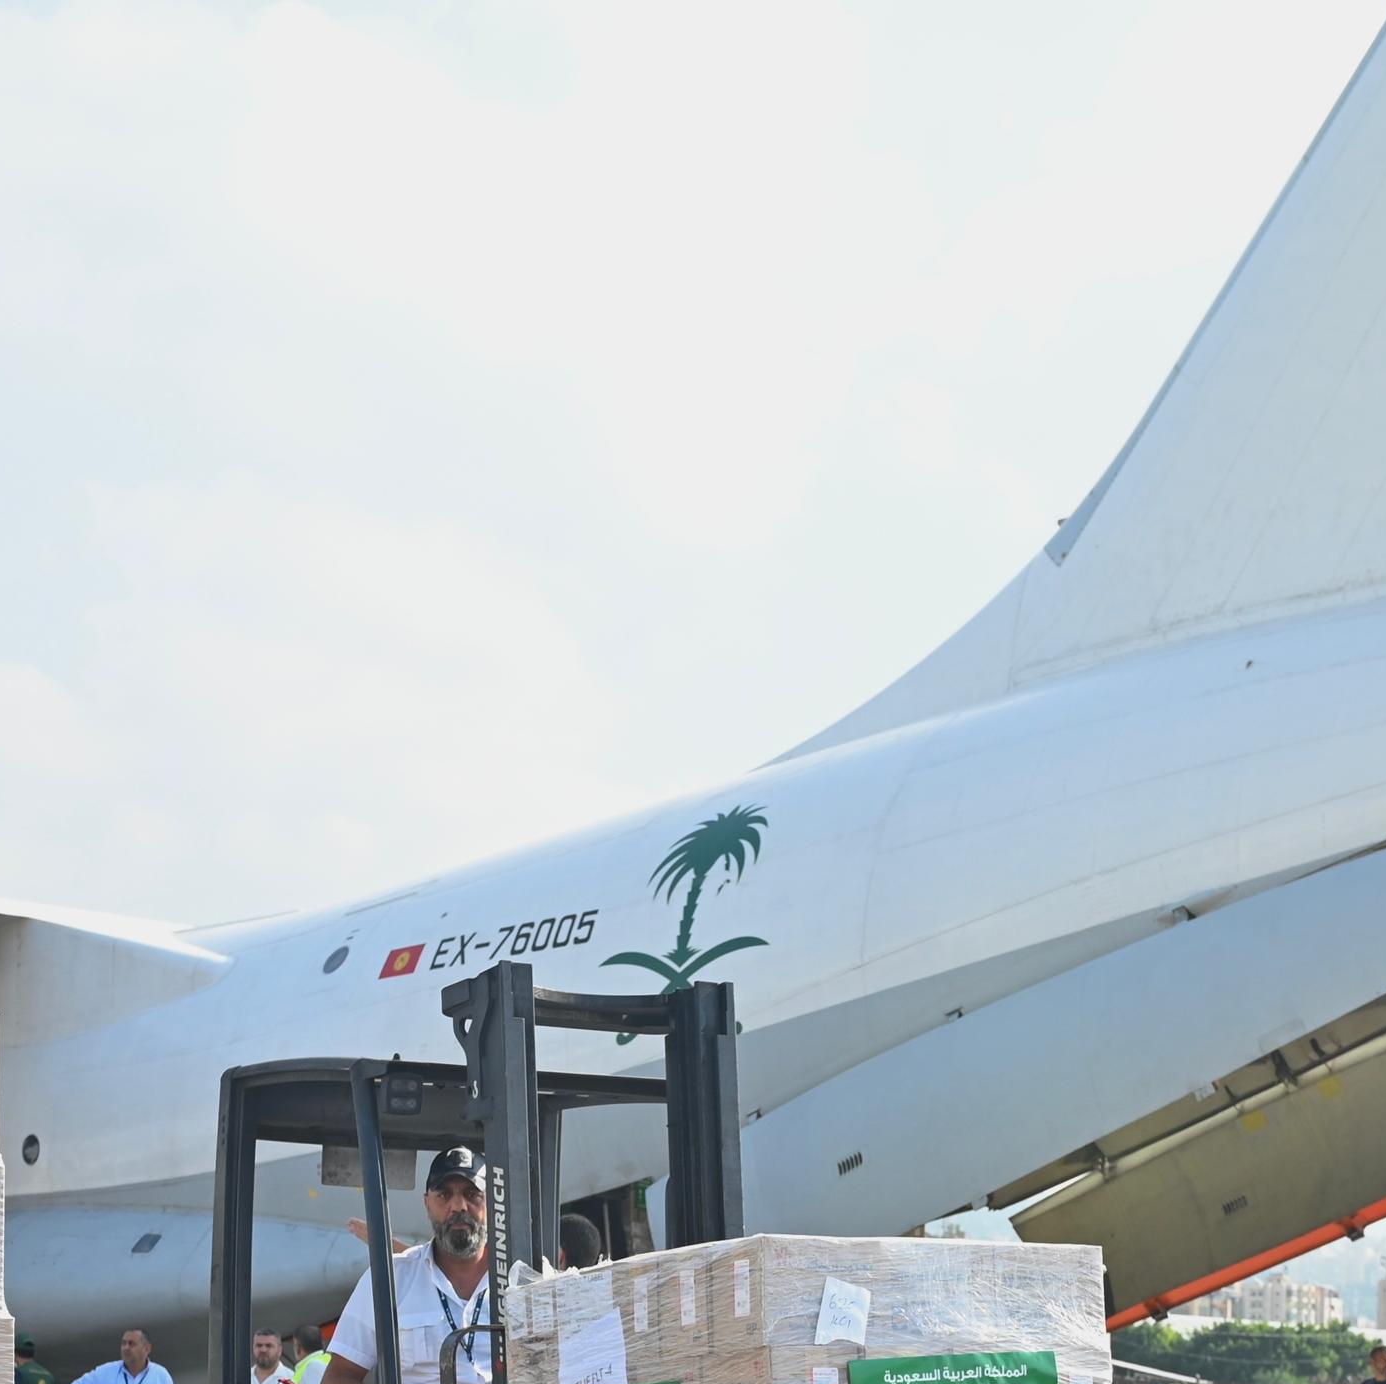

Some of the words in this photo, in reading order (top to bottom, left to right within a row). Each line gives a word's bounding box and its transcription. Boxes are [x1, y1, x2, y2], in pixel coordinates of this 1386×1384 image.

[430, 910, 599, 970] EX-76005
[493, 1166, 508, 1363] GHEINRICH
[884, 1369, 940, 1384] السعودية
[943, 1366, 981, 1382] العربية
[984, 1364, 1027, 1377] المملكة
